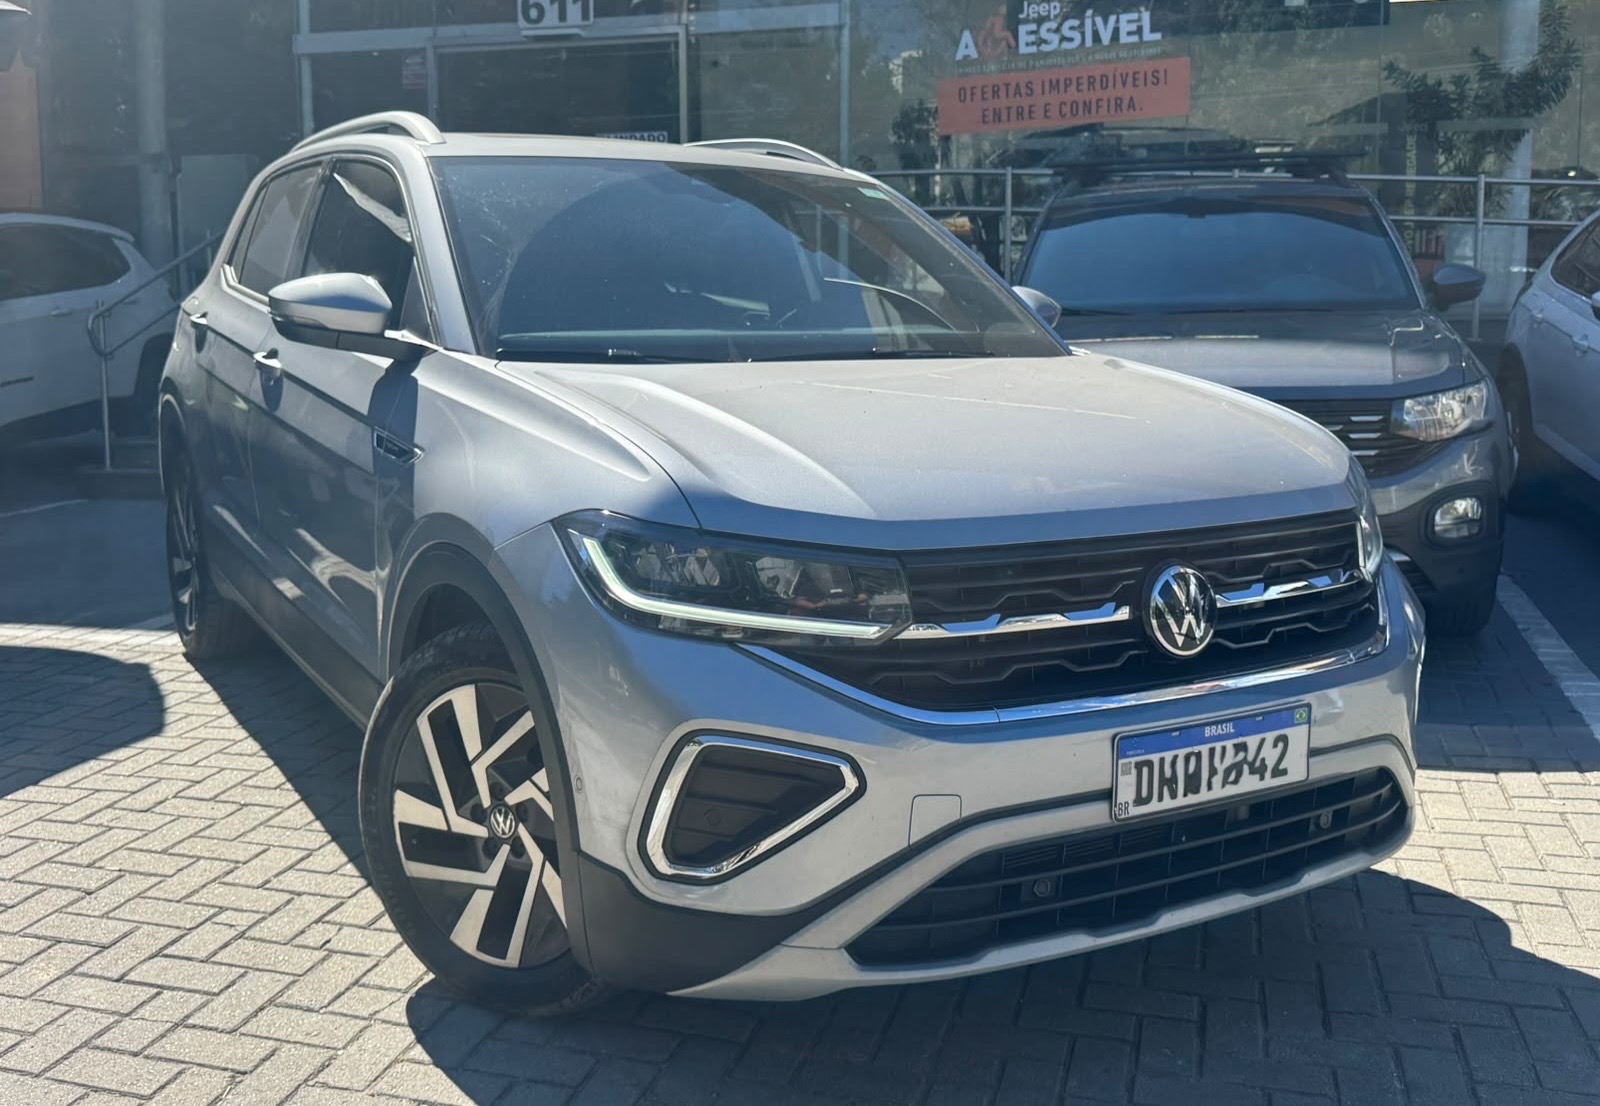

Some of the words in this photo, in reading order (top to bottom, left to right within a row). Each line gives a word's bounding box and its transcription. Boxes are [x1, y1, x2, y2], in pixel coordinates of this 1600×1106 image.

[521, 0, 590, 25] 611
[1018, 0, 1060, 20] Jeep
[958, 80, 1034, 104] OFERTAS
[1041, 67, 1168, 97] IMPERDÍVEIS!
[981, 103, 1037, 125] ENTRE
[1043, 102, 1053, 119] E
[1058, 95, 1143, 118] CONFIRA.
[1204, 722, 1236, 737] BRASIL
[1116, 800, 1130, 818] BR
